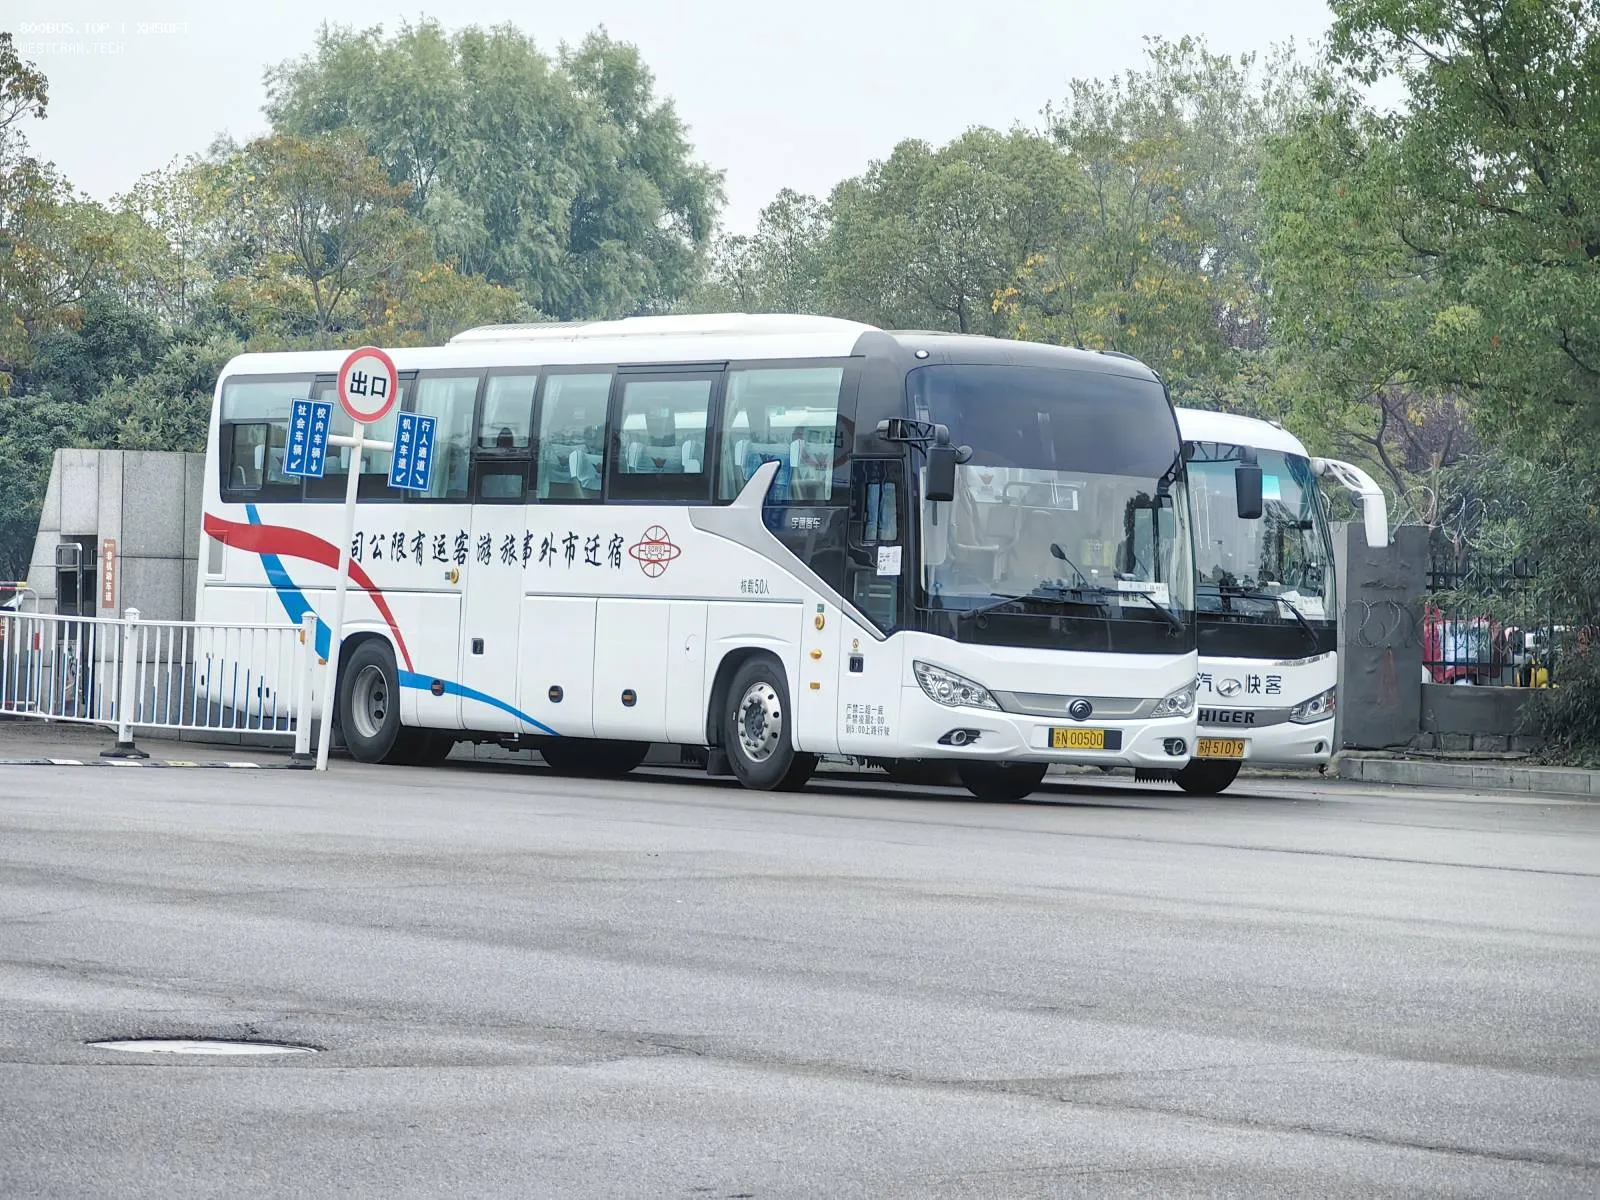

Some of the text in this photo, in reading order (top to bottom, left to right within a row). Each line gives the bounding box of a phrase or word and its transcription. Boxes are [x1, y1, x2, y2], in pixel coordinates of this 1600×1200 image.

[350, 371, 387, 398] 出口
[293, 405, 307, 455] 社会车辆
[311, 408, 326, 458] 校内车辆
[398, 419, 411, 469] 机动车道
[416, 421, 430, 471] 行人通道
[791, 517, 821, 529] 宇通客车
[1245, 674, 1282, 694] 快客
[1199, 710, 1255, 723] HIGER
